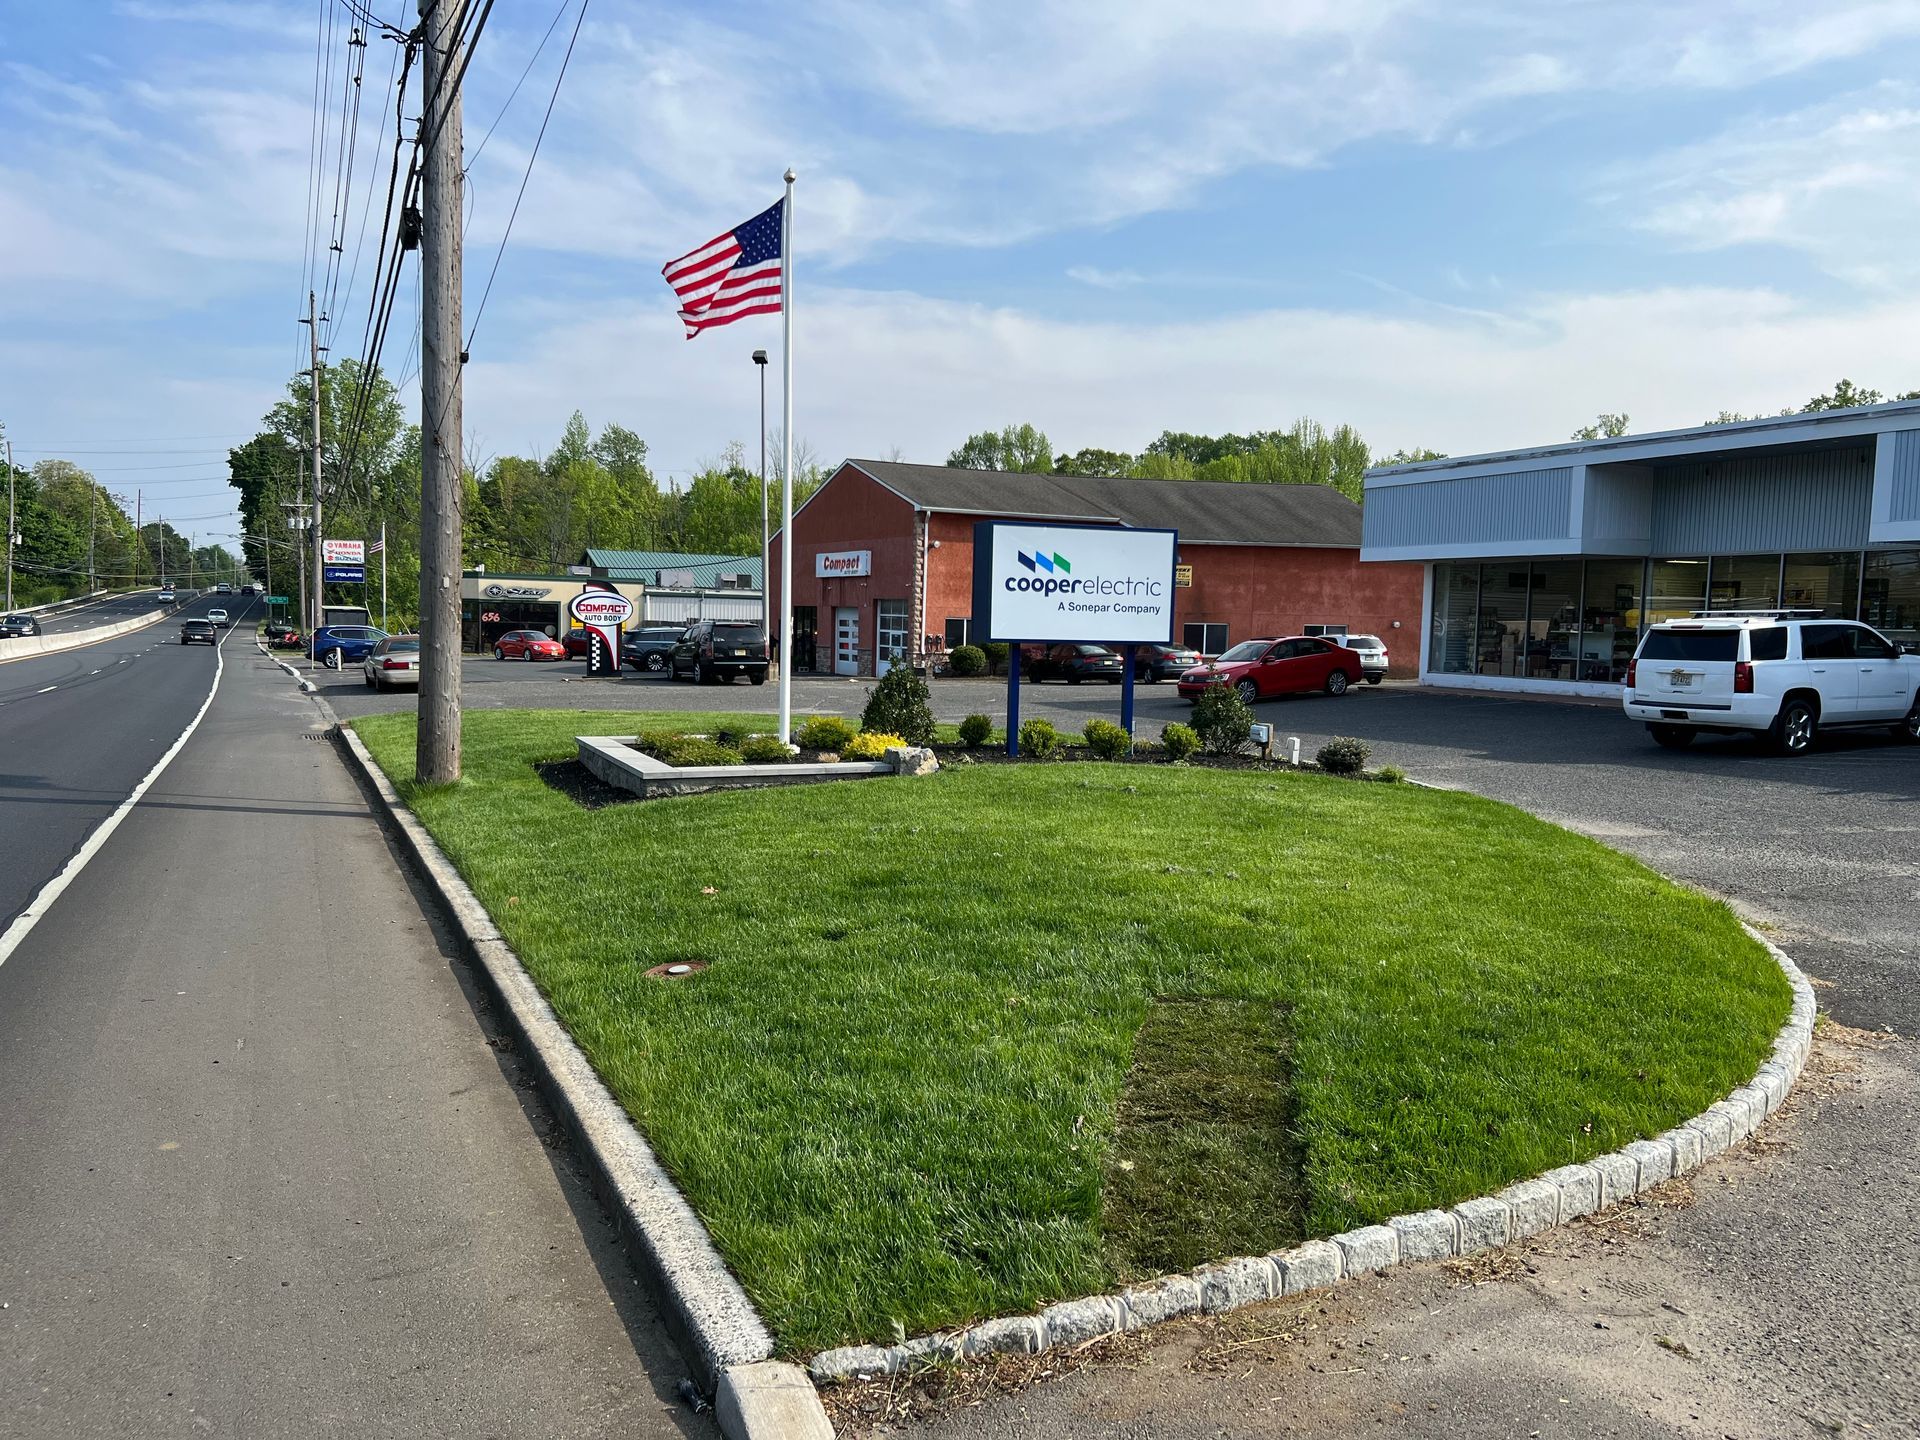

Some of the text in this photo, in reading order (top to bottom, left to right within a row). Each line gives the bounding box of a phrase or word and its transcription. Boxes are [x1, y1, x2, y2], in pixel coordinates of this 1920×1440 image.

[824, 555, 860, 572] Compact
[1005, 575, 1161, 597] cooperelectric
[579, 603, 627, 613] COMPACT
[1058, 602, 1161, 615] A Sonepar Company
[482, 612, 500, 622] 656
